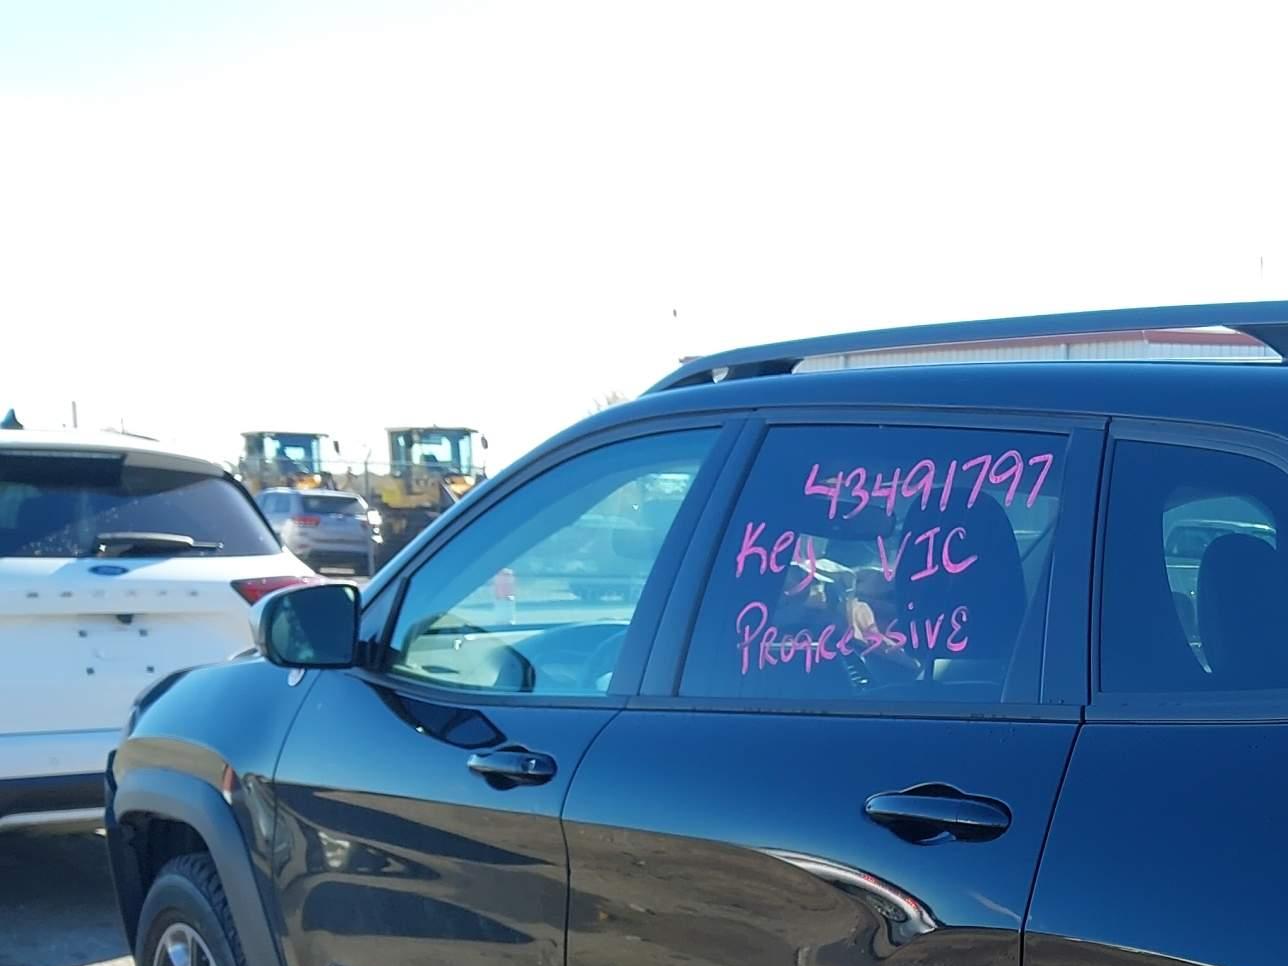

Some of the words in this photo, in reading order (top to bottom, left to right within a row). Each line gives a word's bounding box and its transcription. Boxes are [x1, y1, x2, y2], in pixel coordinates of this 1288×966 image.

[804, 449, 1054, 519] 43491797
[735, 521, 817, 596] Key
[876, 526, 978, 583] VIC
